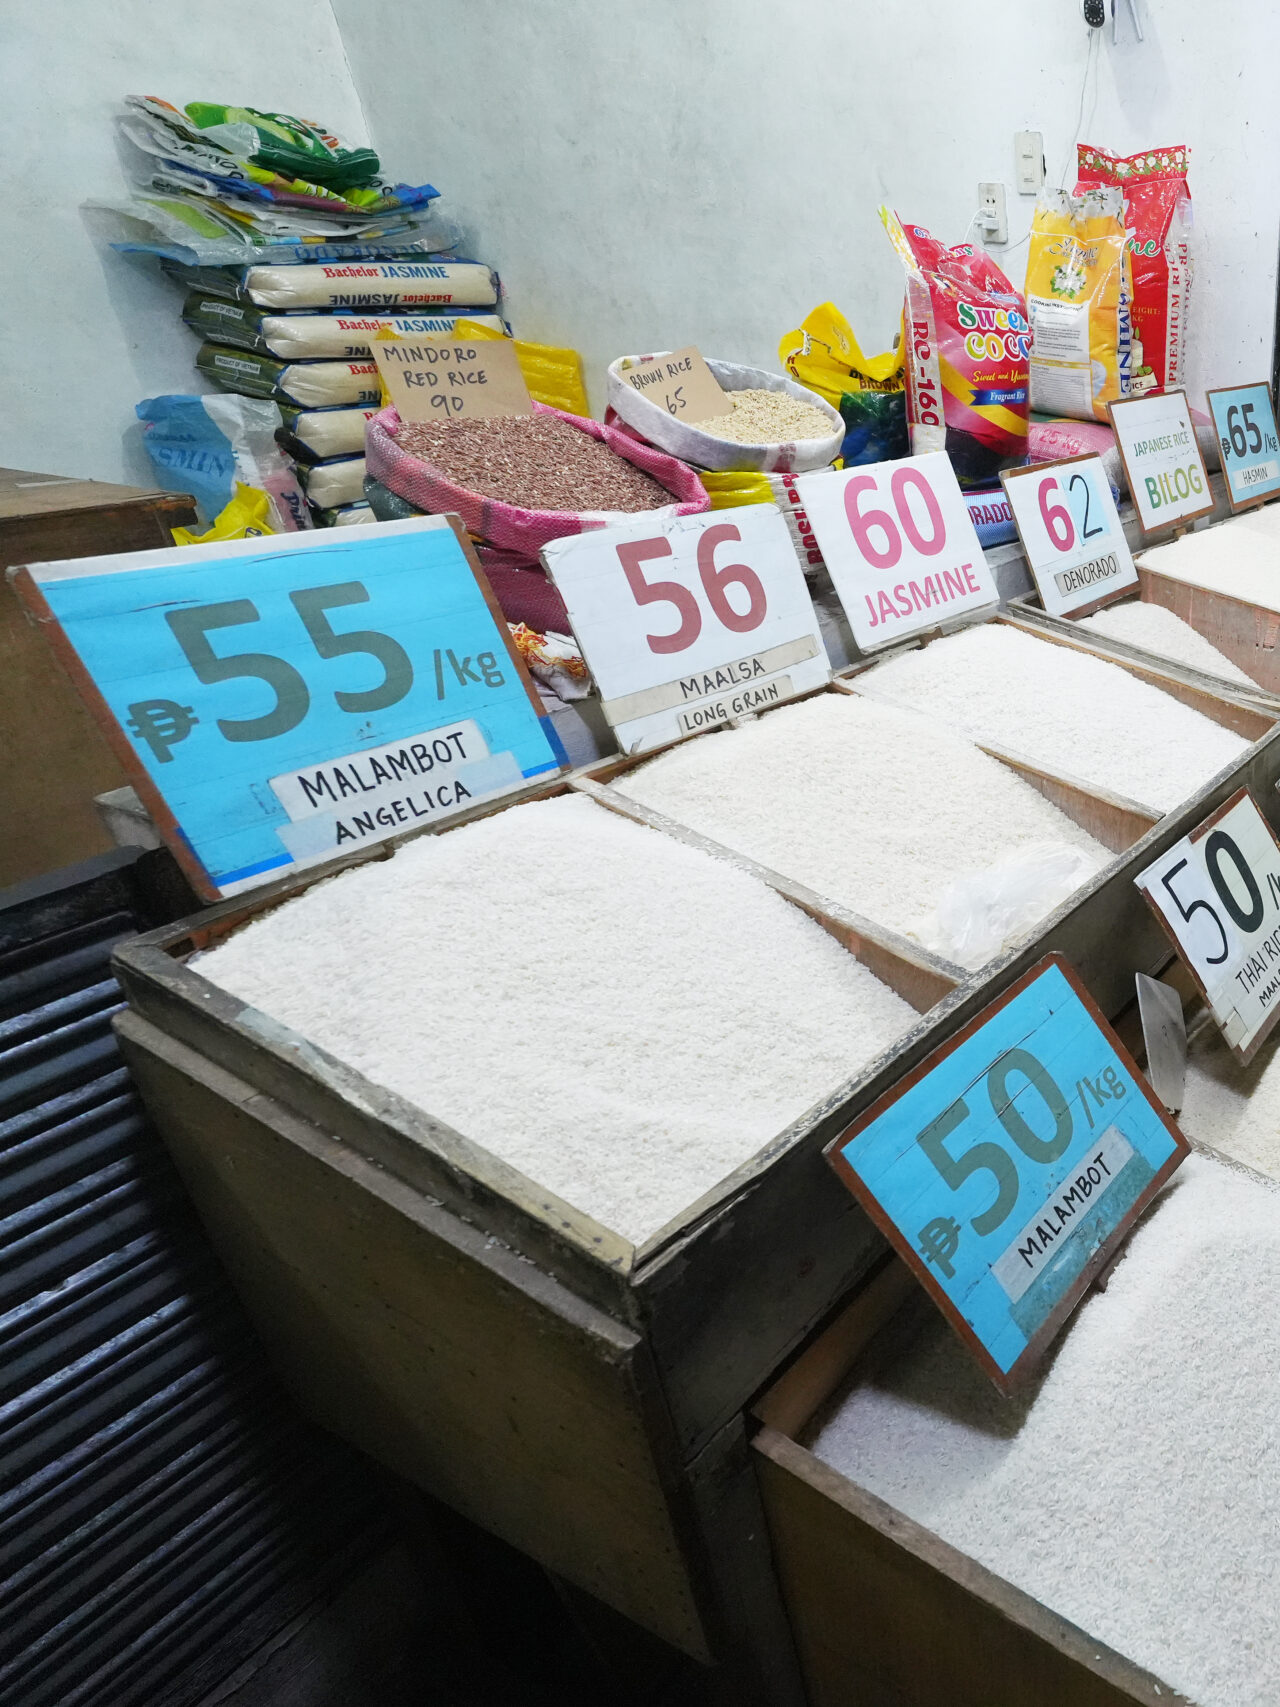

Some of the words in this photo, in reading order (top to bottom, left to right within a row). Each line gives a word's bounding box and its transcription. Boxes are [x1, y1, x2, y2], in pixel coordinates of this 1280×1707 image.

[321, 266, 379, 279] Bachelor
[380, 266, 450, 279] JASMINE
[329, 293, 400, 306] JASMINE
[401, 294, 453, 304] Bachelor
[1132, 306, 1162, 315] EIGHT:
[384, 346, 478, 364] MINDORO
[1168, 294, 1180, 382] PREMIUM
[404, 369, 439, 388] RED
[447, 369, 488, 386] RICE
[630, 366, 664, 390] BROWN
[668, 357, 692, 379] RICE
[430, 394, 464, 417] 90
[666, 386, 689, 415] 65
[990, 391, 1016, 402] Fragrant
[1039, 428, 1060, 444] 25
[1062, 434, 1082, 455] kg
[1134, 436, 1173, 458] JAPANESE
[1173, 431, 1190, 446] RICE
[1144, 464, 1203, 509] BILOG
[1242, 467, 1268, 485] HASMIN
[844, 467, 946, 569] 60
[1037, 474, 1103, 552] 62
[616, 524, 767, 654] 56
[1064, 554, 1118, 592] DENORADO
[864, 563, 981, 628] JASMINE
[680, 658, 766, 699] MAALSA
[683, 703, 728, 730] LONG
[732, 683, 779, 714] GRAIN
[297, 731, 467, 808] MALAMBOT
[335, 780, 472, 846] ANGELICA
[1235, 946, 1267, 995] THAI
[1017, 1152, 1116, 1268] MALAMBOT
